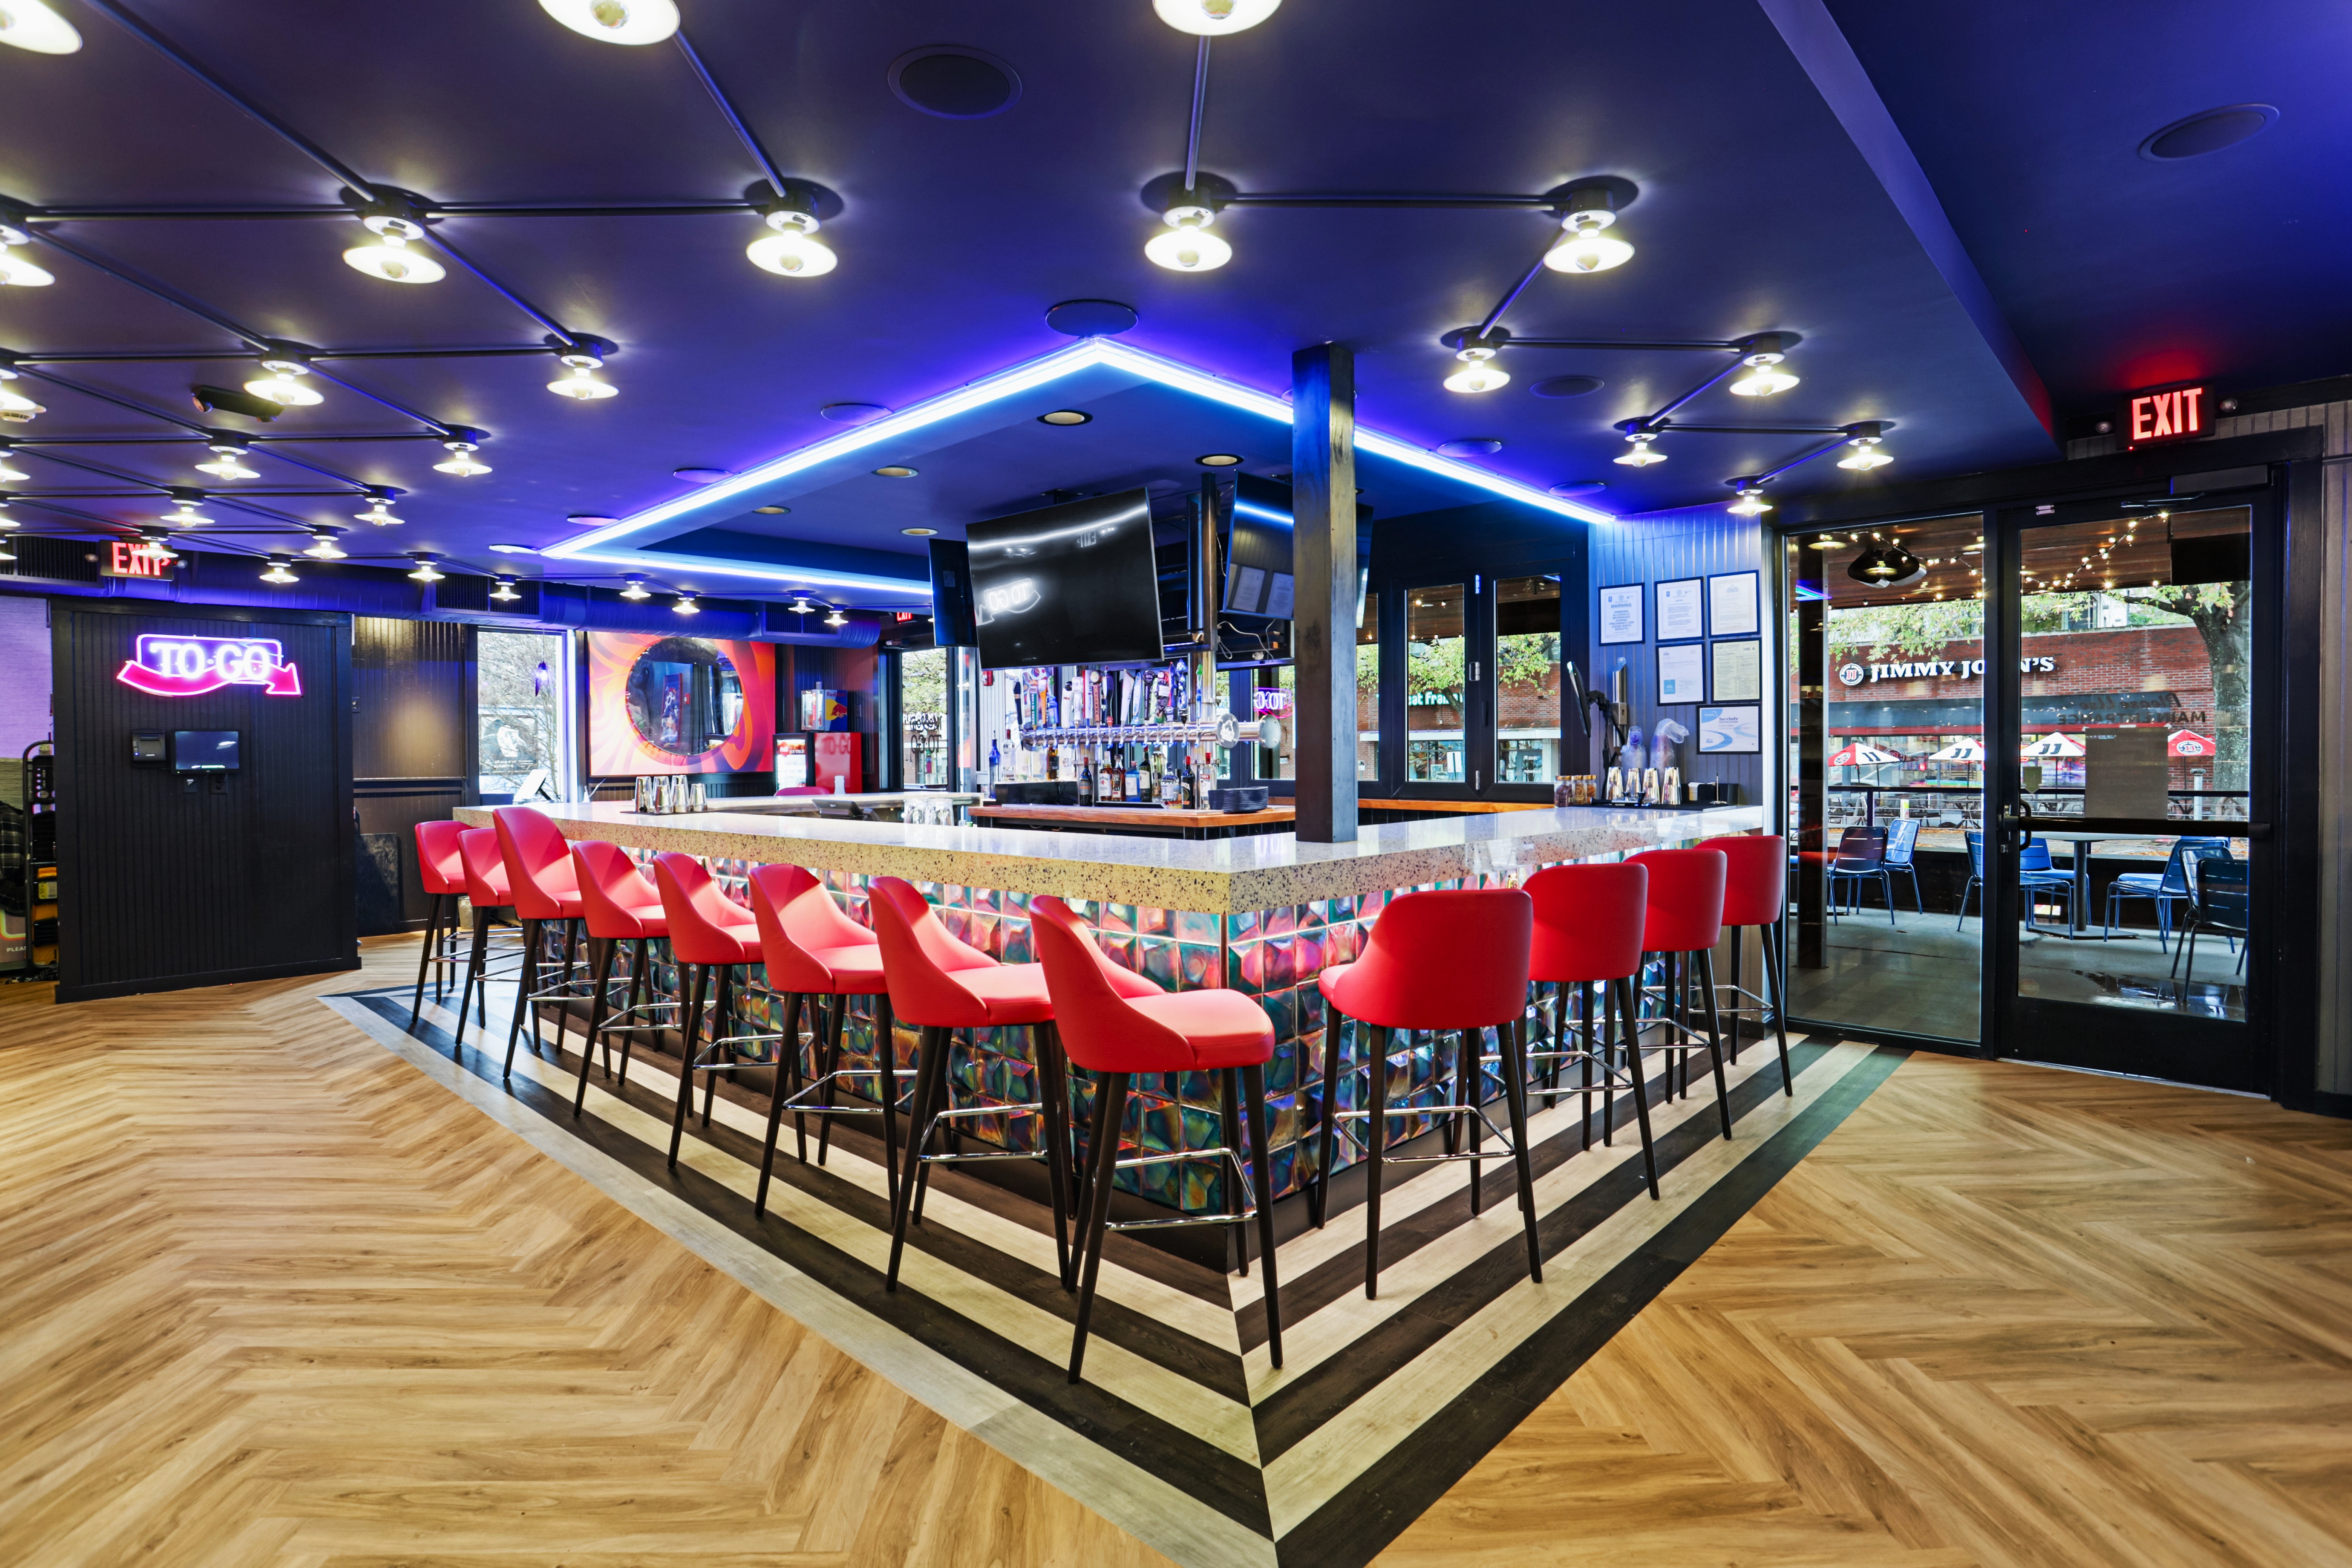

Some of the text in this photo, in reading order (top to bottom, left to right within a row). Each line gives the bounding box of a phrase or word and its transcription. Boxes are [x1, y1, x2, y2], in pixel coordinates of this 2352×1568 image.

[2132, 387, 2203, 440] EXIT
[1846, 669, 1857, 680] JJ
[1870, 657, 2055, 682] JIMMY JON'S
[1950, 748, 1973, 758] JJ
[2038, 743, 2062, 754] JJ
